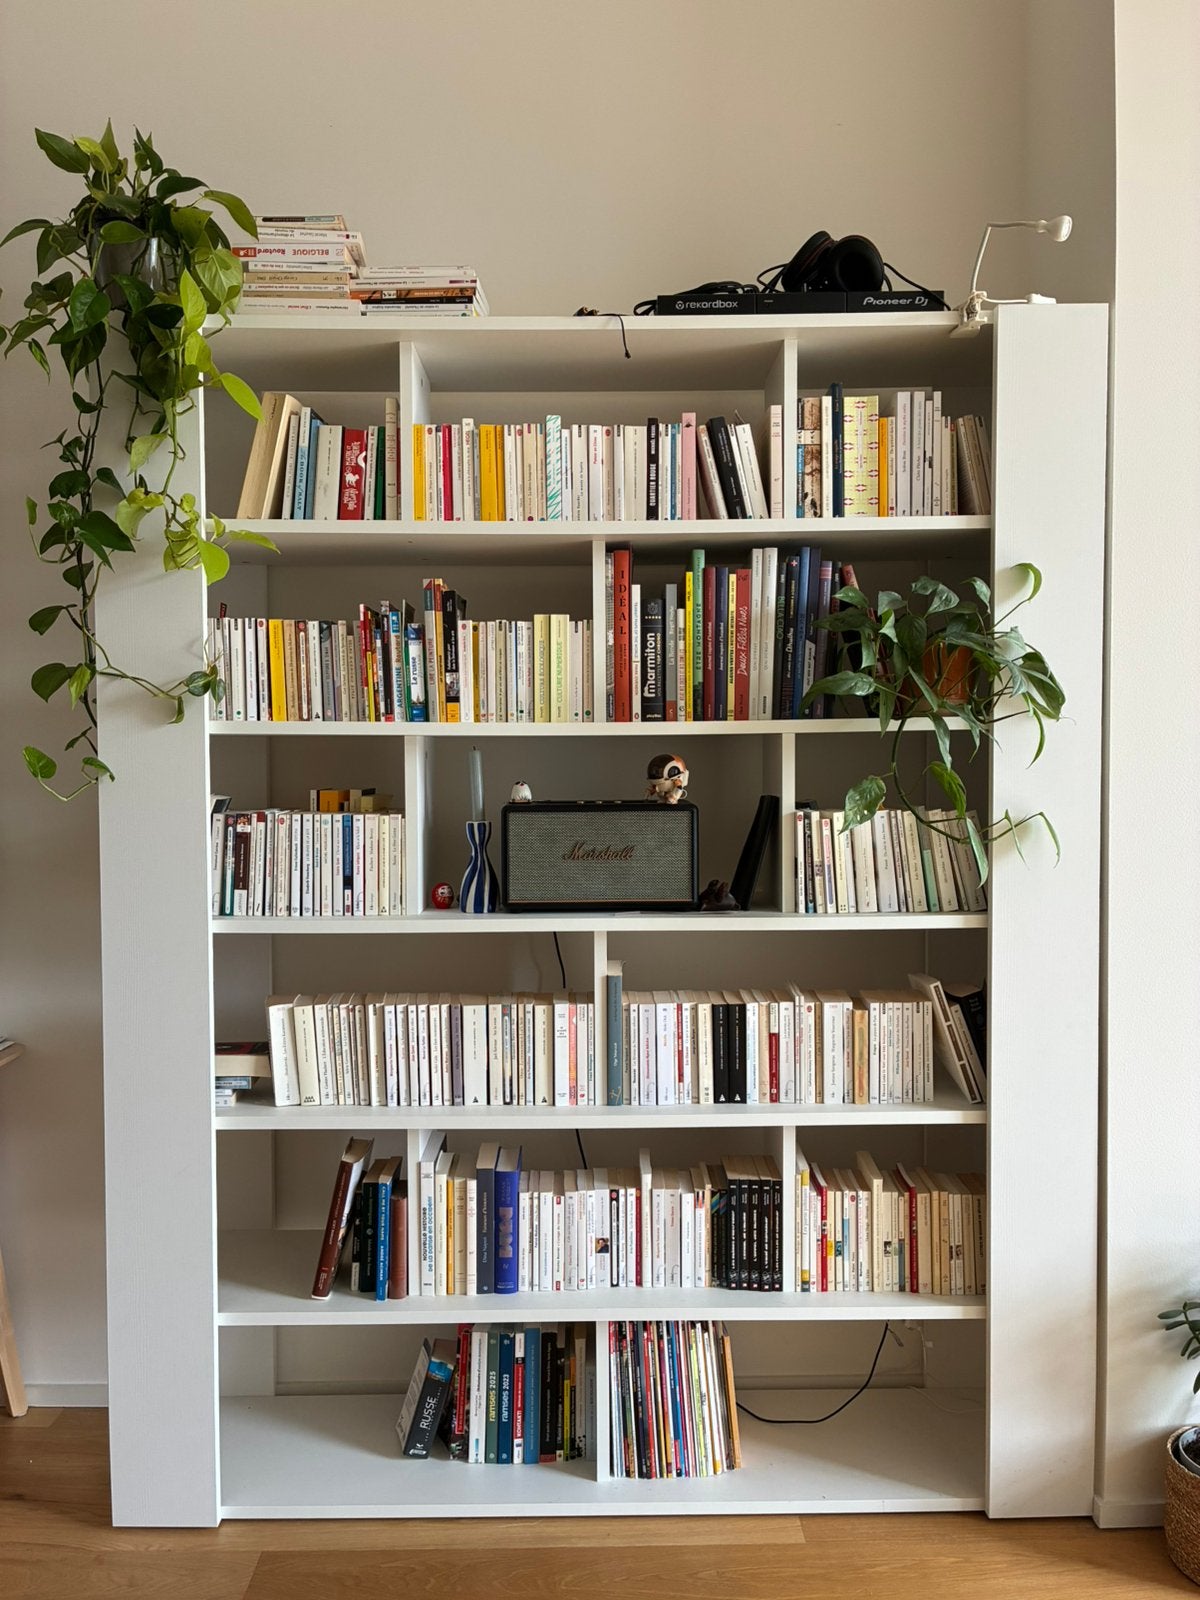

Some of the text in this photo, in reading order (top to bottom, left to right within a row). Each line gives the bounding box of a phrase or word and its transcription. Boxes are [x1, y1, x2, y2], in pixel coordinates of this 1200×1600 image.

[686, 301, 738, 309] rekordbox
[915, 298, 928, 307] DJ
[737, 606, 748, 677] Deux Filles Nues
[643, 633, 655, 697] marmiton
[564, 841, 634, 862] Marshall
[419, 1396, 437, 1428] RUSSE
[501, 1391, 509, 1422] ramses
